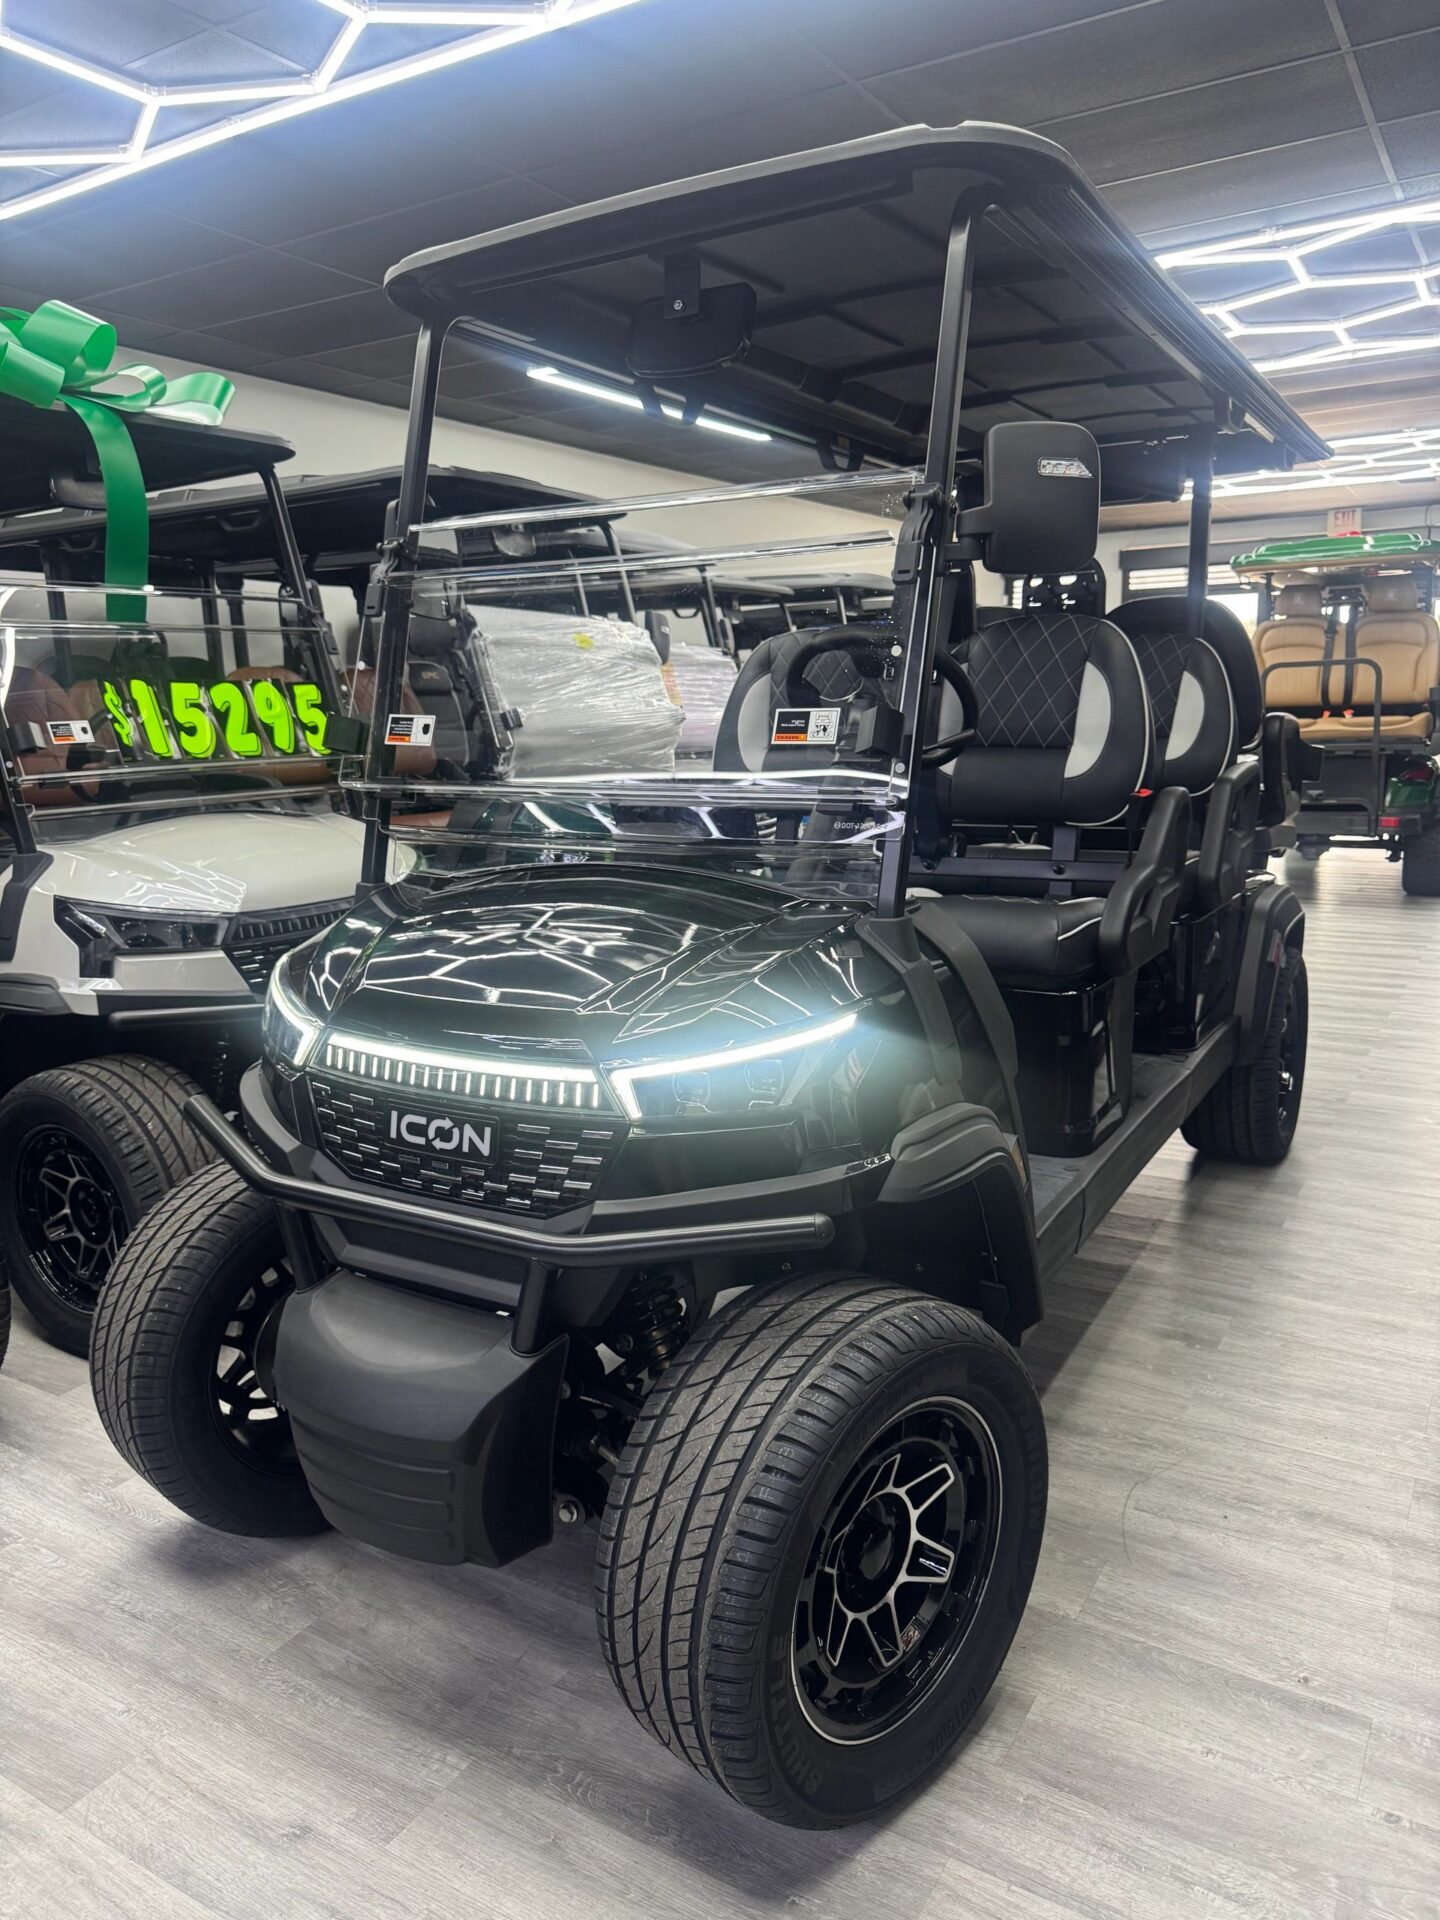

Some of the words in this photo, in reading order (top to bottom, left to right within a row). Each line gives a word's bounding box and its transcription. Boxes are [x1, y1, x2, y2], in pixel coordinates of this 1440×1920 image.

[1334, 509, 1357, 527] EXIT
[103, 678, 332, 757] $15295
[390, 1110, 491, 1157] ICON
[771, 1634, 824, 1796] SHUTTLE
